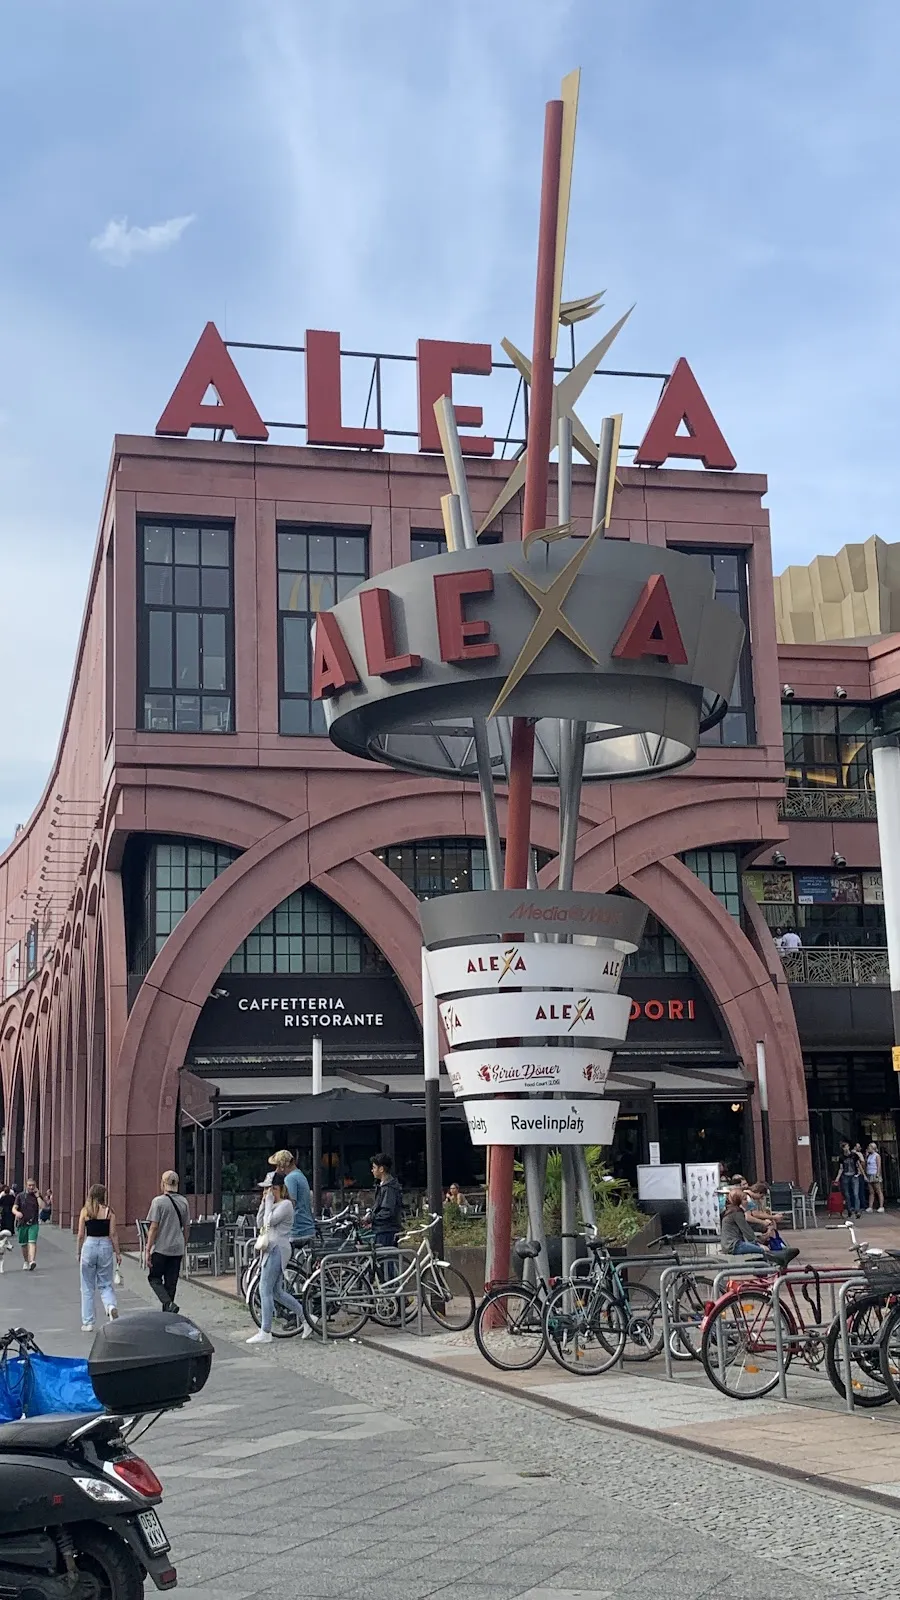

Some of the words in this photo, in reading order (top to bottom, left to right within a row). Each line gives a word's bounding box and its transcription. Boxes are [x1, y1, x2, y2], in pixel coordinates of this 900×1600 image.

[155, 303, 737, 537] ALEXA
[312, 518, 689, 721] ALEXA
[467, 947, 527, 983] ALEXA
[238, 998, 345, 1011] CAFFETTERIA
[535, 996, 595, 1032] ALEXA
[284, 1014, 384, 1027] RISTORANTE
[521, 1063, 561, 1080] Döner
[511, 1114, 584, 1133] Ravelinplatz
[140, 1512, 157, 1530] 063
